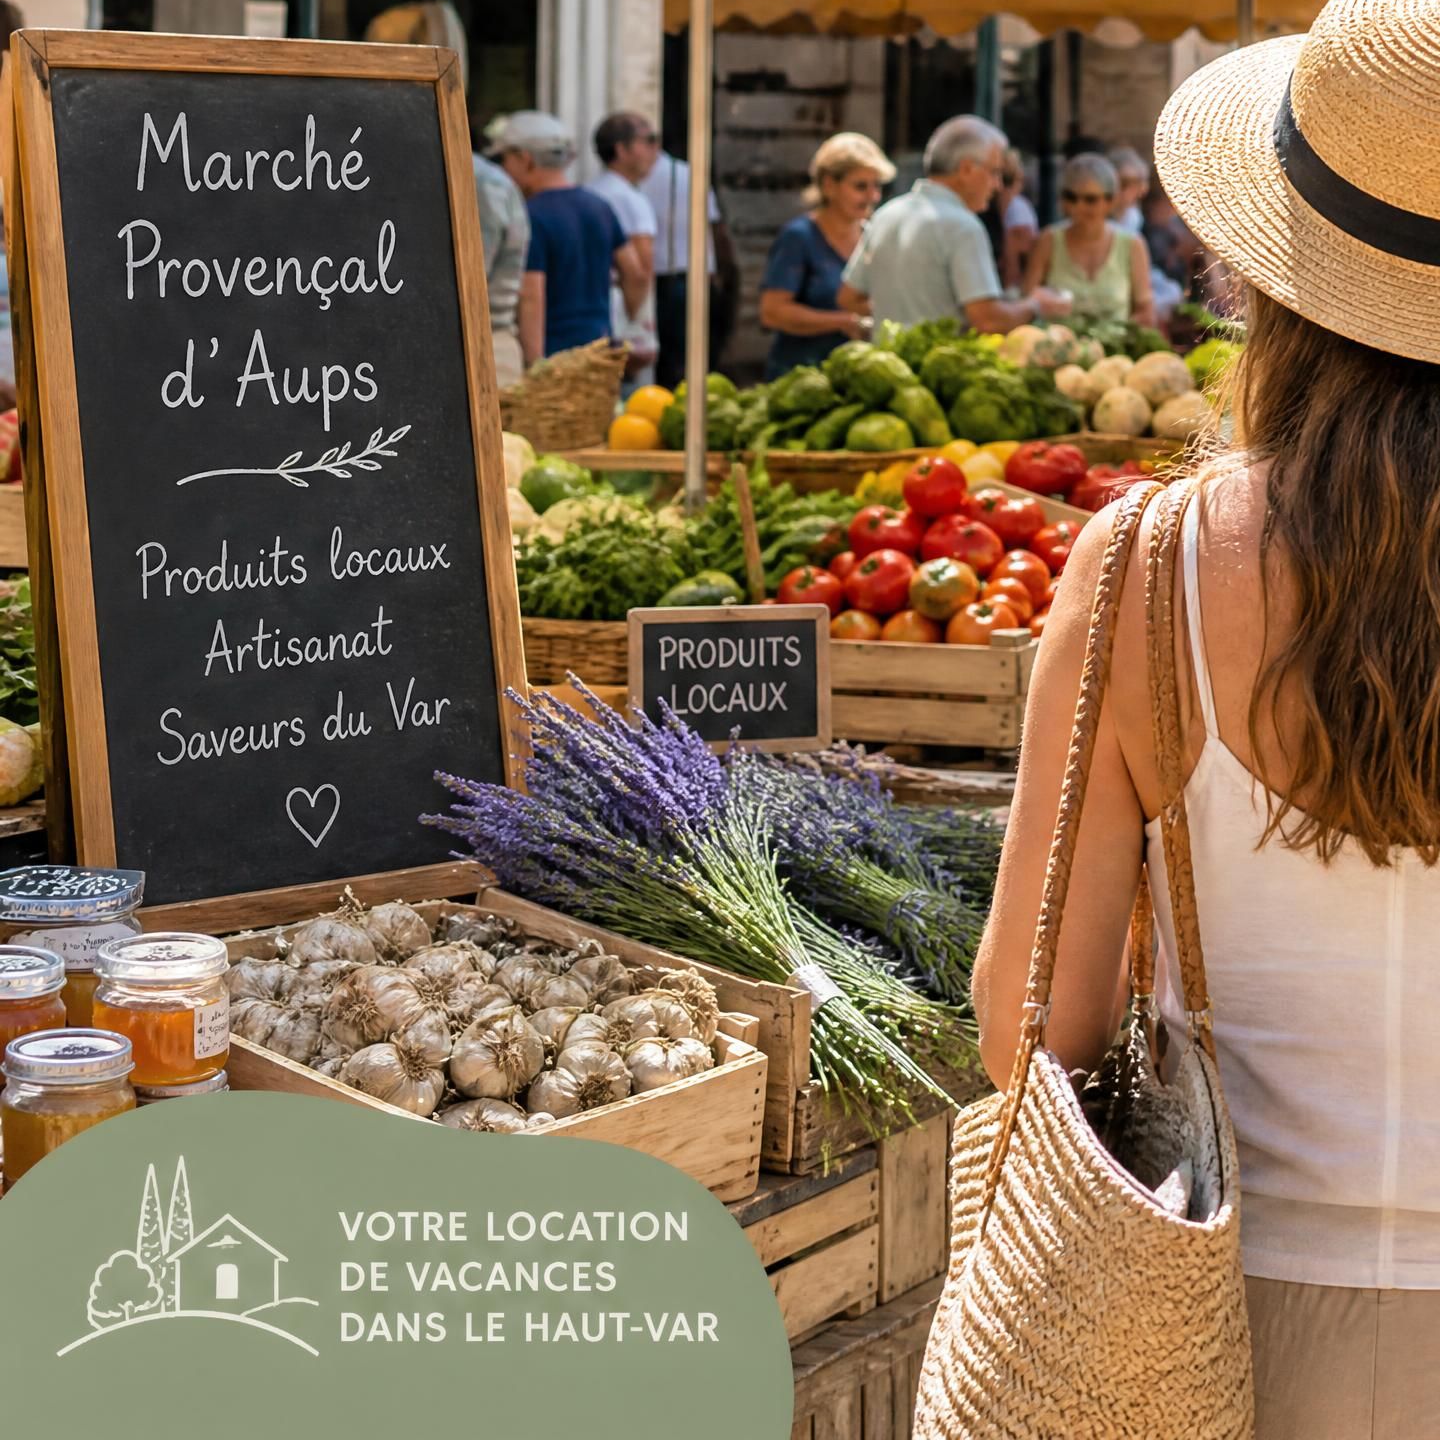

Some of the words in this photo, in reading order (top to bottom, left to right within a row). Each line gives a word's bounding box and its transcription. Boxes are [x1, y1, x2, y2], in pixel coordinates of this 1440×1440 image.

[137, 112, 370, 192] Marché
[118, 219, 403, 310] Provençal
[136, 536, 307, 599] Produits
[331, 526, 450, 579] locaux
[205, 606, 392, 676] Artisanat
[659, 636, 801, 670] PRODUITS
[157, 708, 305, 765] Saveurs
[323, 691, 371, 740] du
[387, 677, 450, 730] Var
[671, 681, 787, 714] LOCAUX
